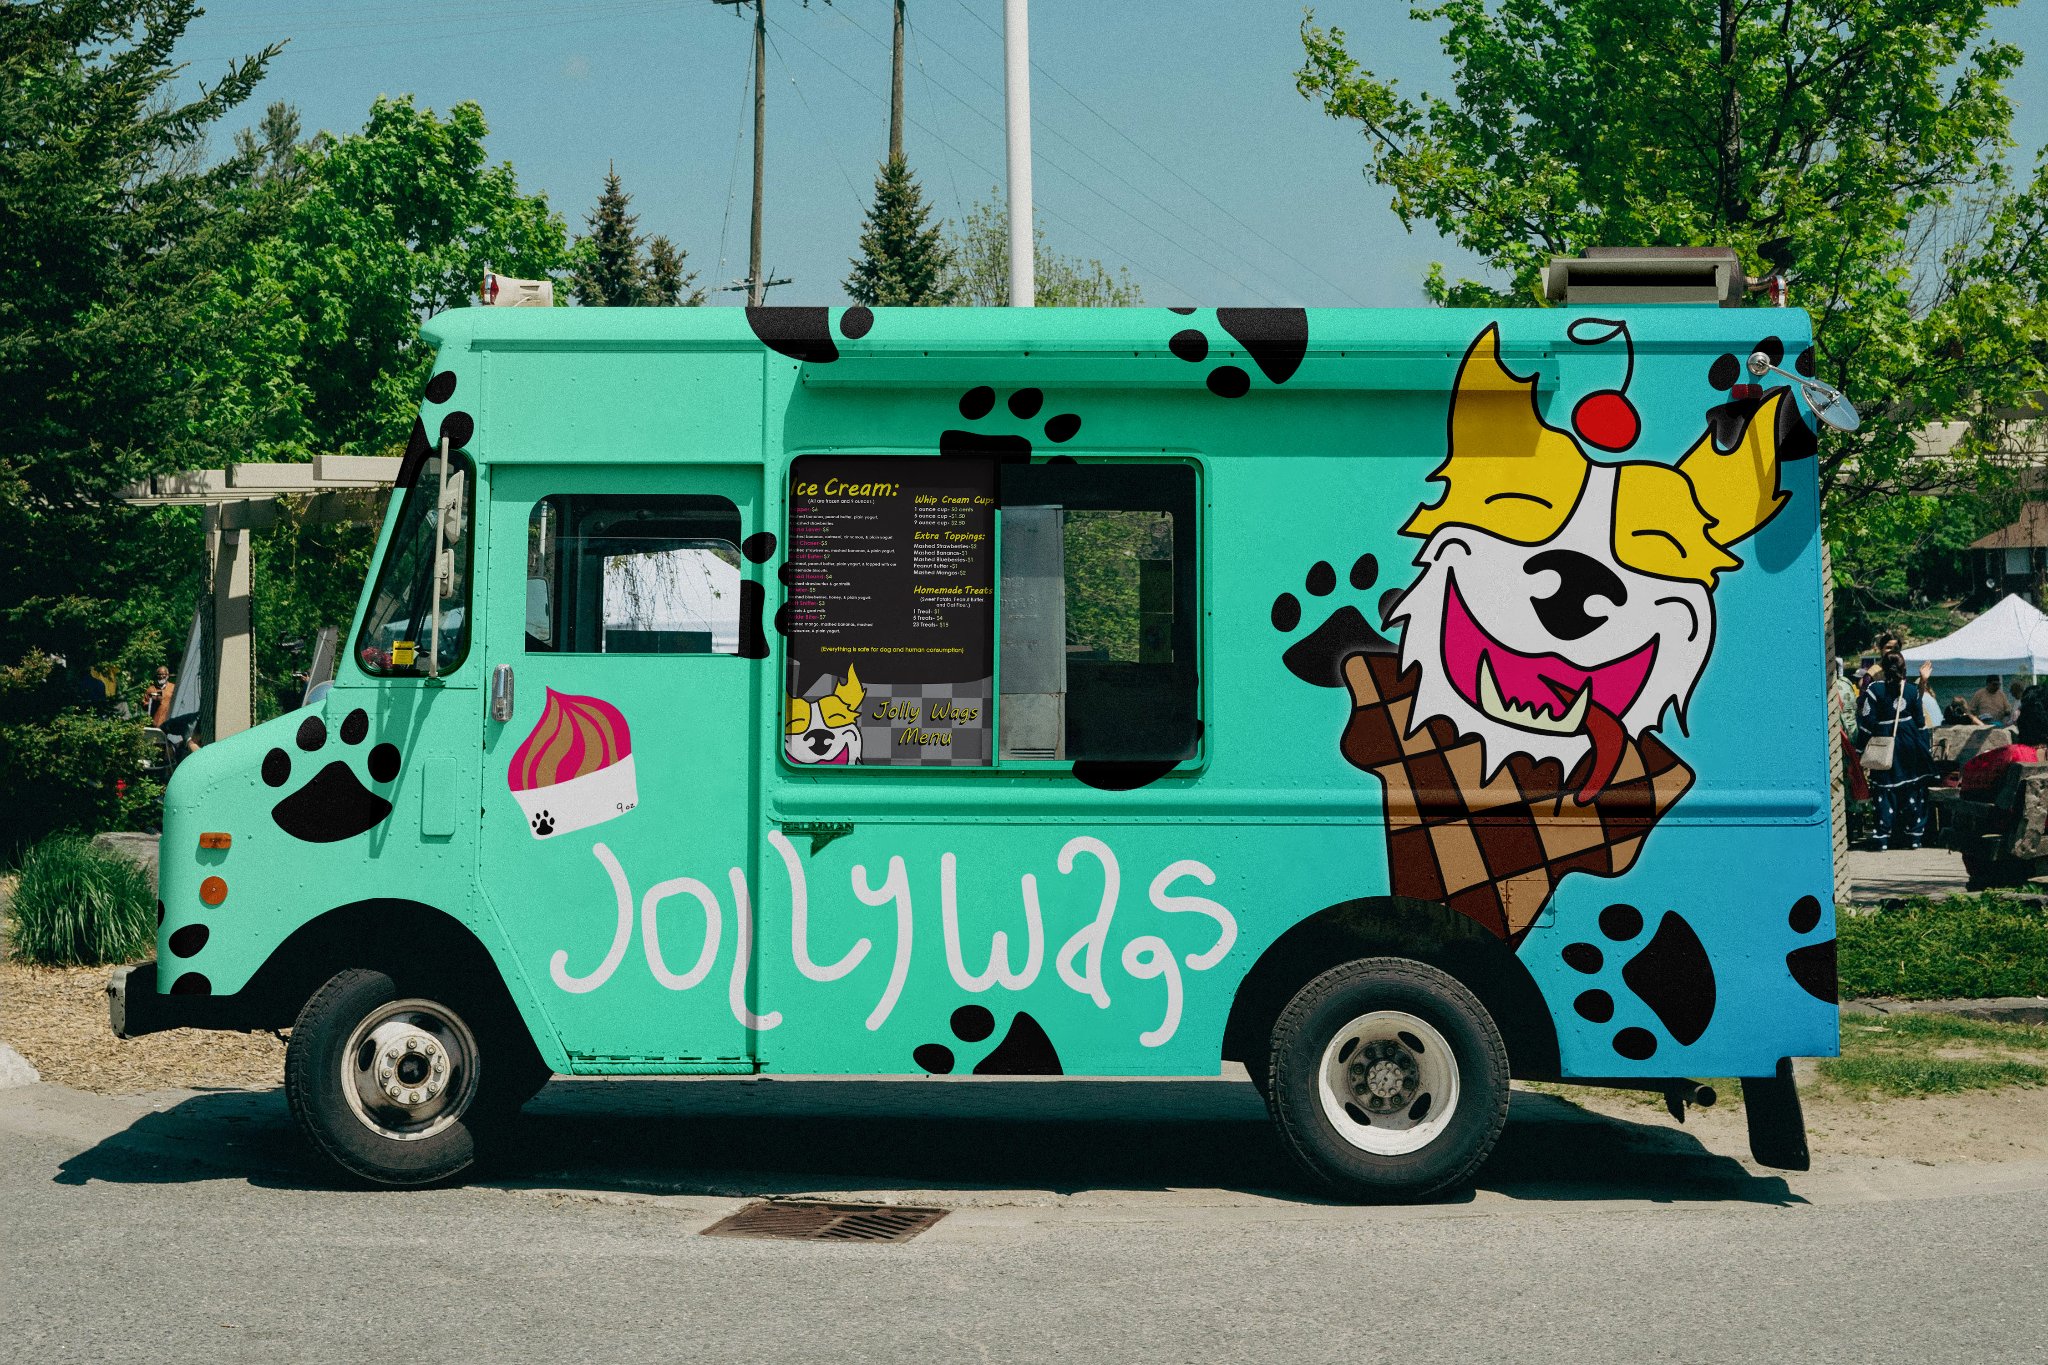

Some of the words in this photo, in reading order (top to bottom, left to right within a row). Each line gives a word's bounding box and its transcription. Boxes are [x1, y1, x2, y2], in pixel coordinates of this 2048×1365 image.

[824, 477, 899, 497] Cream:
[914, 495, 938, 505] Whip
[941, 495, 970, 505] Cream
[914, 532, 939, 540] Extra
[944, 531, 985, 542] Toppings:
[914, 585, 963, 594] Homemade
[964, 585, 993, 594] Treats
[873, 700, 920, 724] Jolly
[930, 700, 979, 724] Wags
[898, 727, 953, 746] Menu
